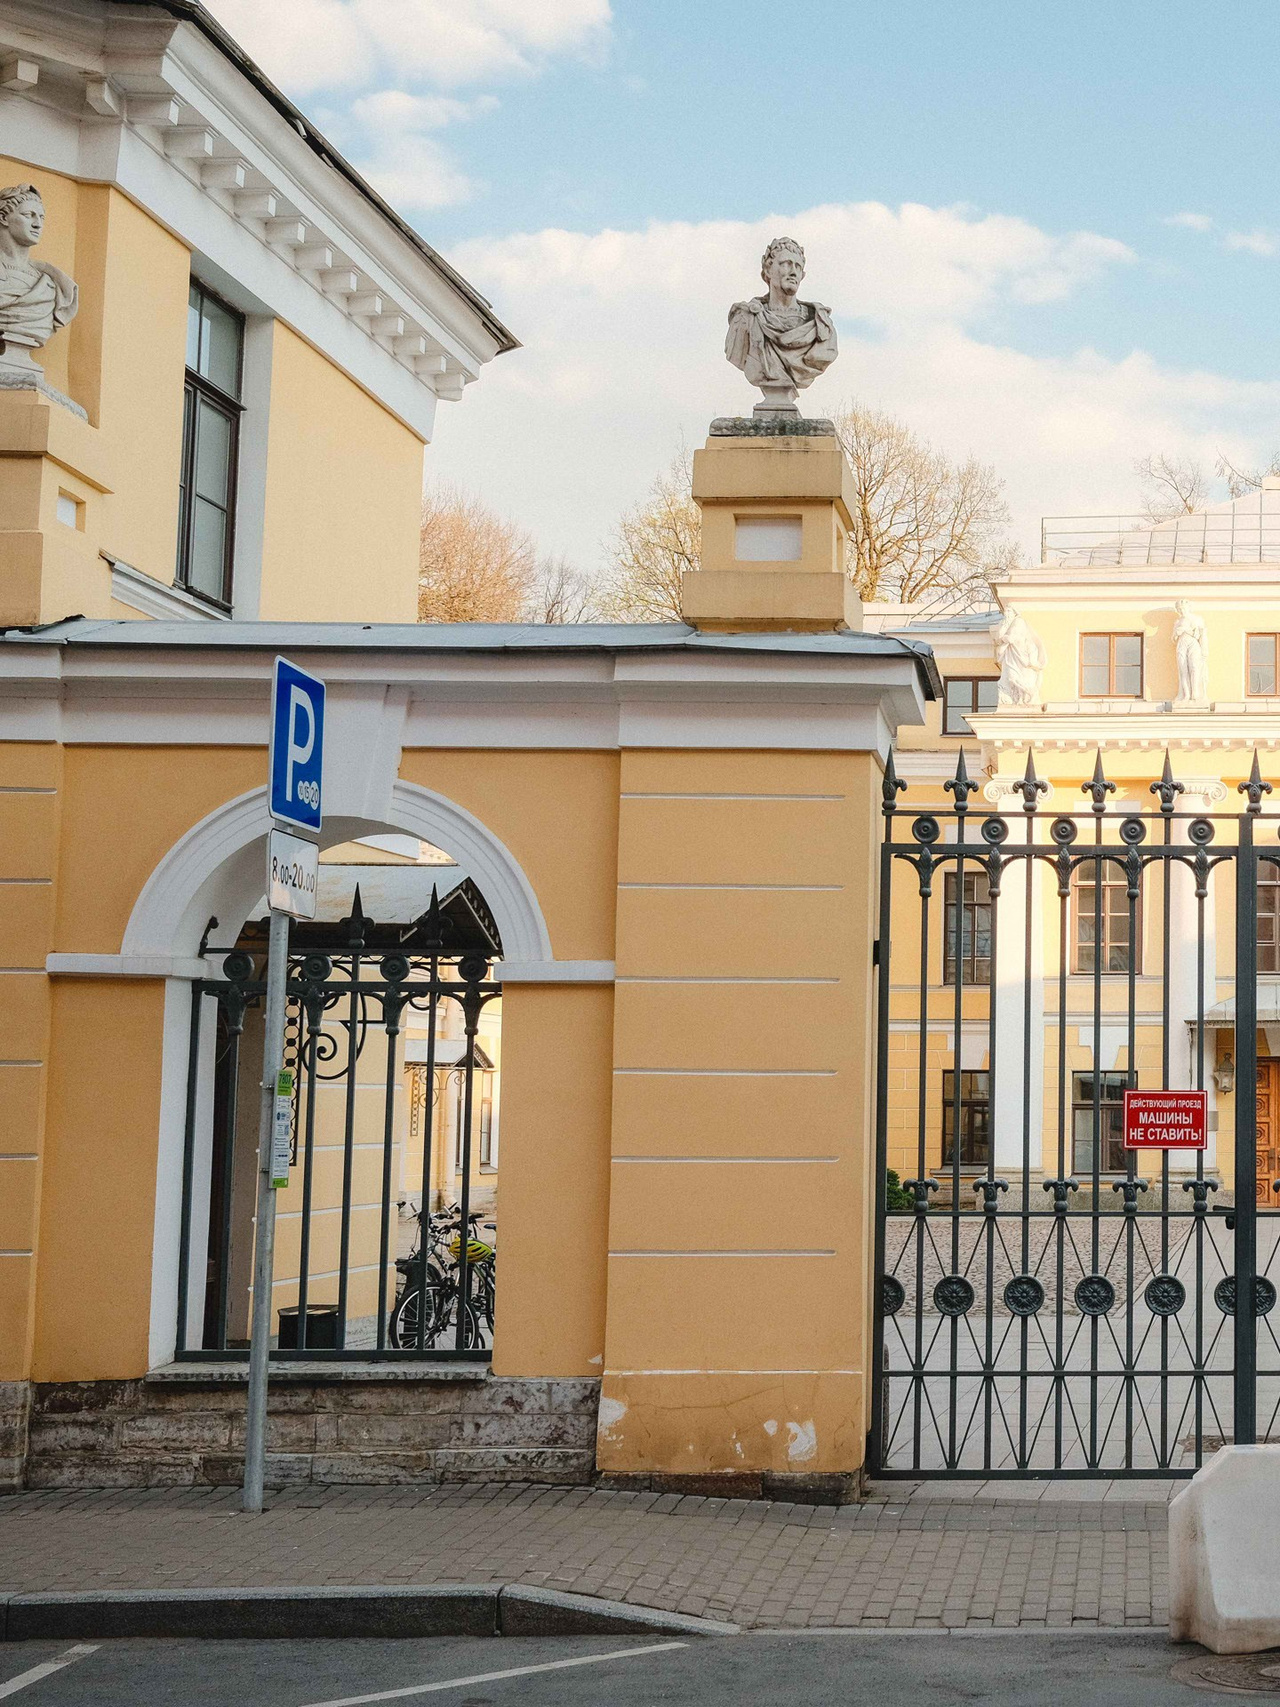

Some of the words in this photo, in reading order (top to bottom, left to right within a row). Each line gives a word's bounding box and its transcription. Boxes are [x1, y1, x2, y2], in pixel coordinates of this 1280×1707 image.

[286, 684, 315, 803] P
[310, 787, 319, 804] 20
[272, 856, 315, 893] 8.00-20.00
[1129, 1098, 1177, 1109] ДЕЙСТВУЮЩИЙ
[1177, 1099, 1202, 1109] ПРОЕЗД
[1139, 1111, 1193, 1124] МАШИНЫ
[1129, 1128, 1145, 1140] НЕ
[1147, 1128, 1202, 1140] СТАВИТЬ!
